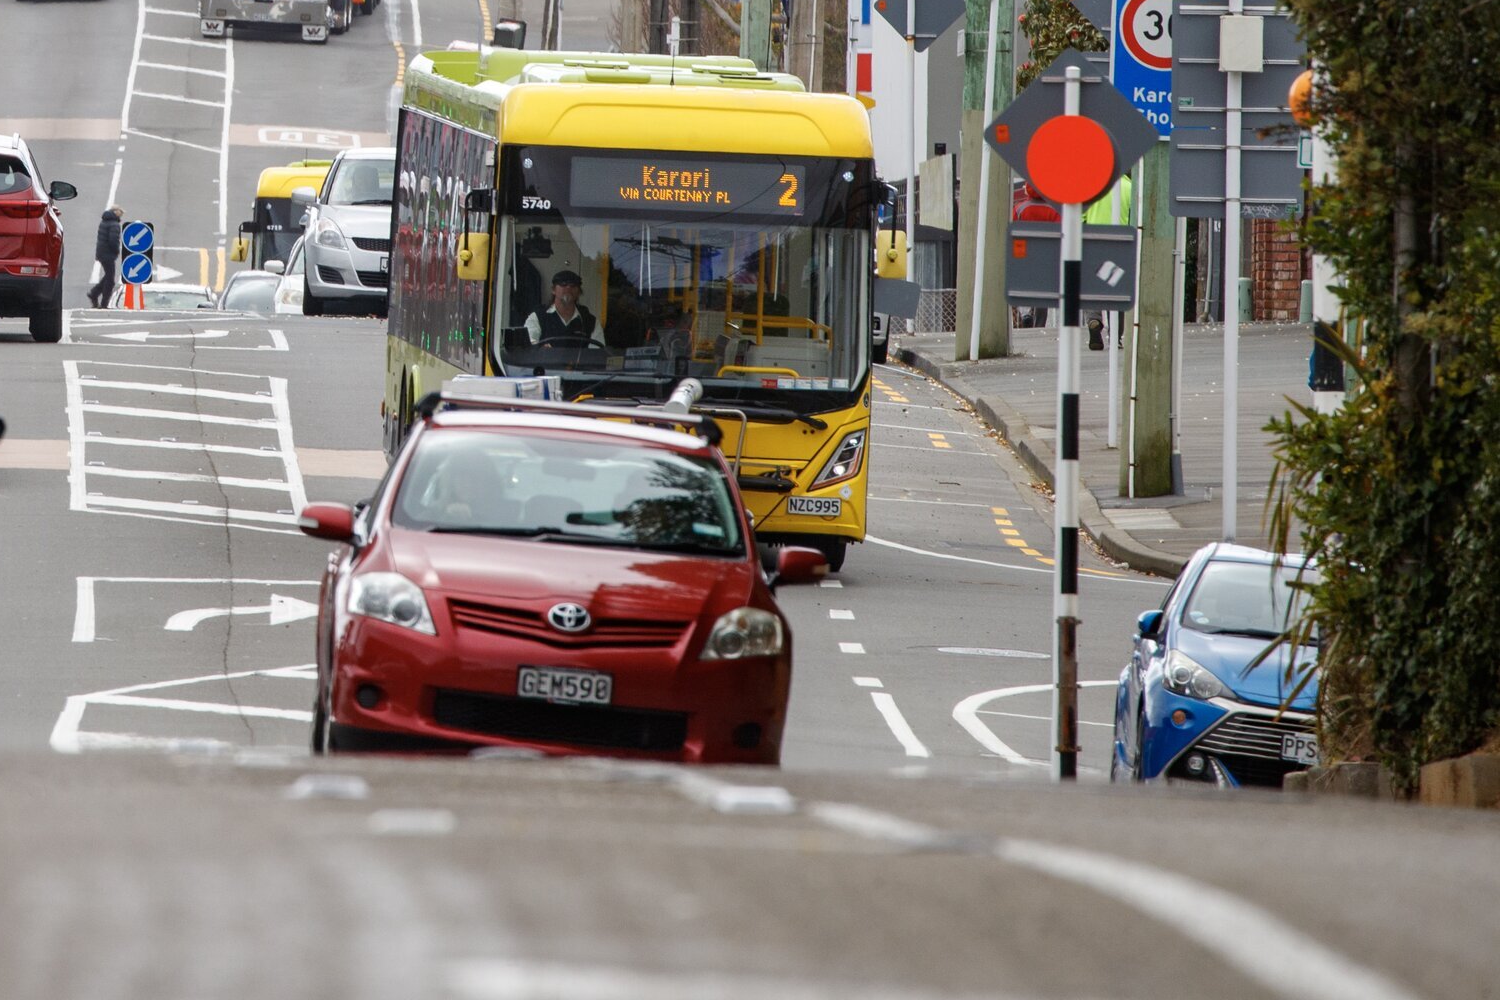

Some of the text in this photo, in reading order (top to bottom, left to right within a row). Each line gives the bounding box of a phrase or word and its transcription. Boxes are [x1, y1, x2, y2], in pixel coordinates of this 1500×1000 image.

[642, 165, 798, 207] Karori 2
[620, 186, 731, 204] VIA COURTENAY PL
[522, 199, 552, 210] 5740
[789, 498, 840, 514] NZC995
